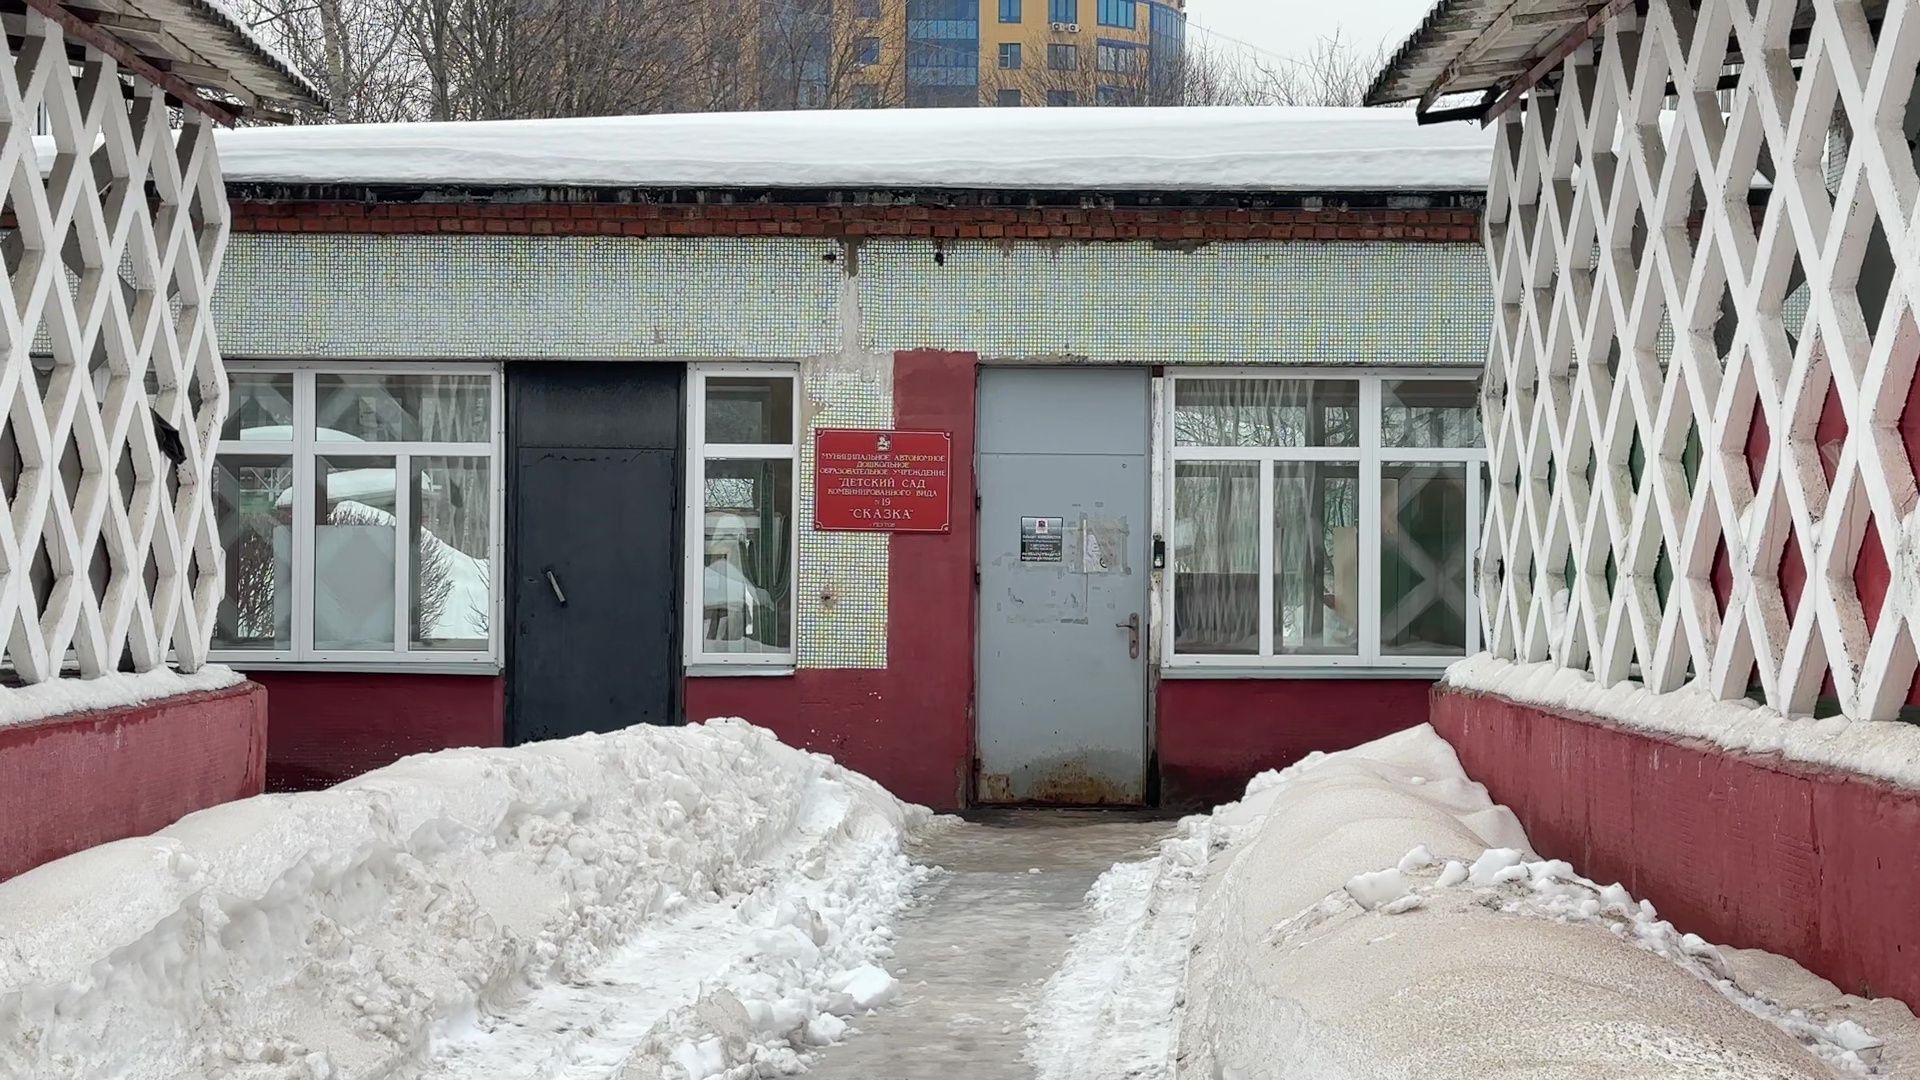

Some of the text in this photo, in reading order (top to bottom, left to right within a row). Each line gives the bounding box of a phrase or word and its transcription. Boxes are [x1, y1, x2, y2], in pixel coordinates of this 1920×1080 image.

[902, 480, 925, 488] САД
[916, 490, 937, 498] ВИДА
[850, 508, 913, 519] "СКАЗКА"
